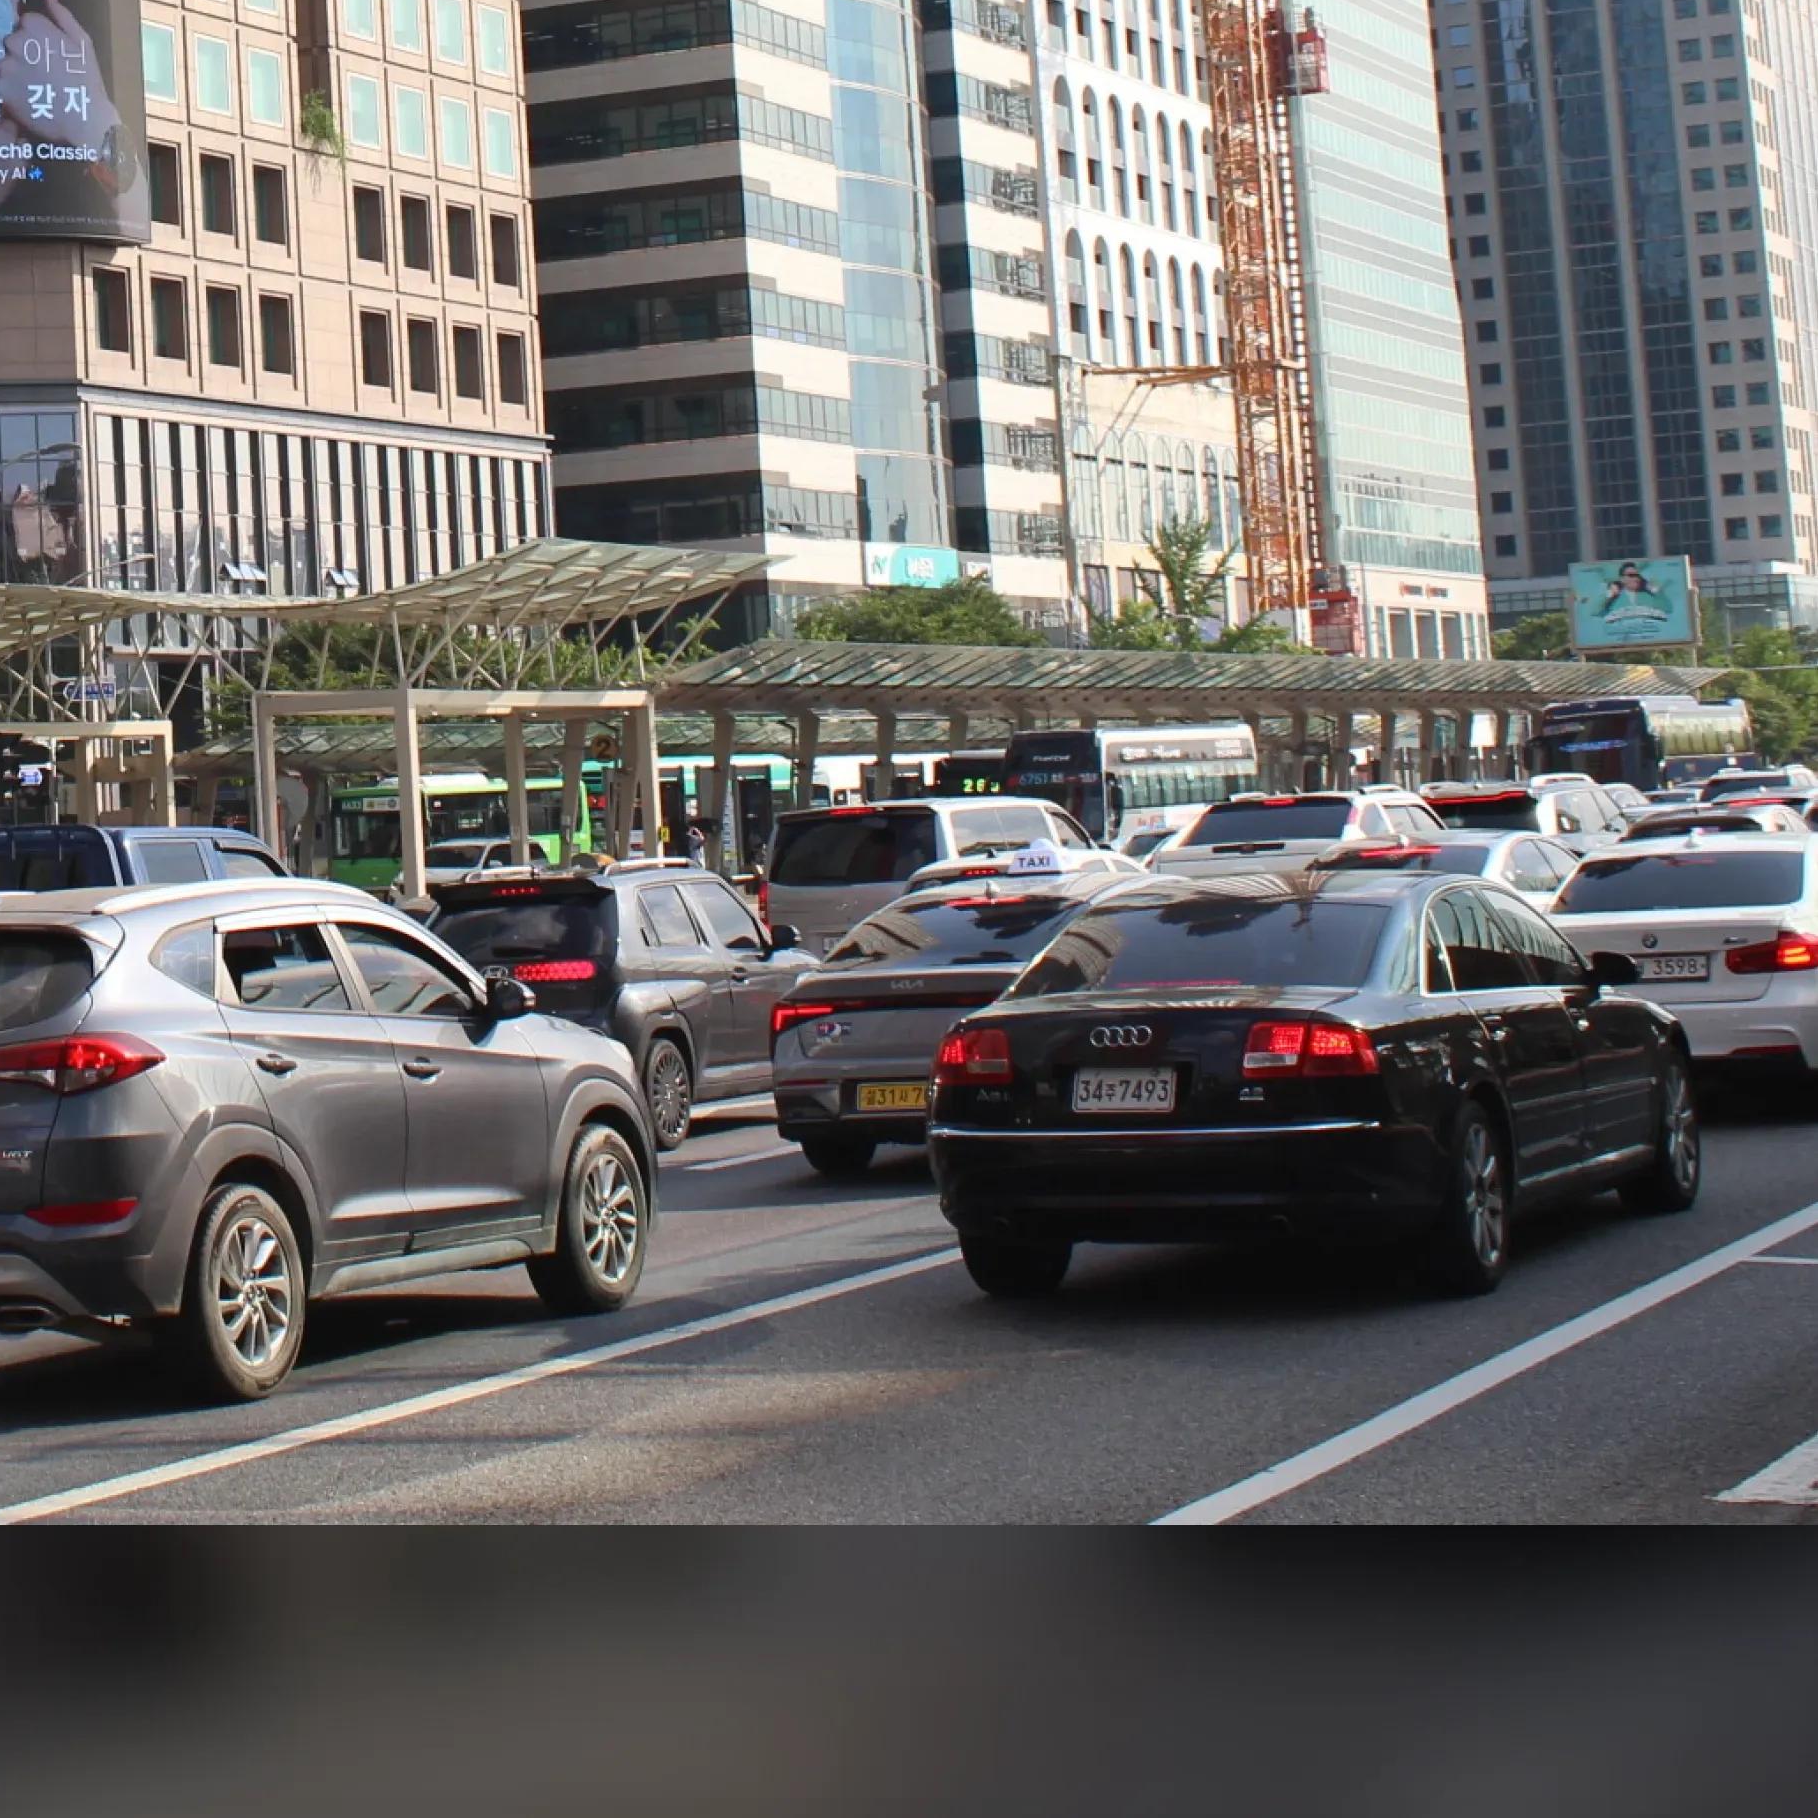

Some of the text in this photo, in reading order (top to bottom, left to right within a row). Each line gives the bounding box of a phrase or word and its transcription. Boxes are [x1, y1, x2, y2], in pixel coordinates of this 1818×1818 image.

[23, 36, 88, 74] 아닌
[26, 83, 92, 121] 갖자
[36, 143, 99, 162] Classic
[11, 167, 27, 180] AI
[1017, 856, 1051, 869] TAXI
